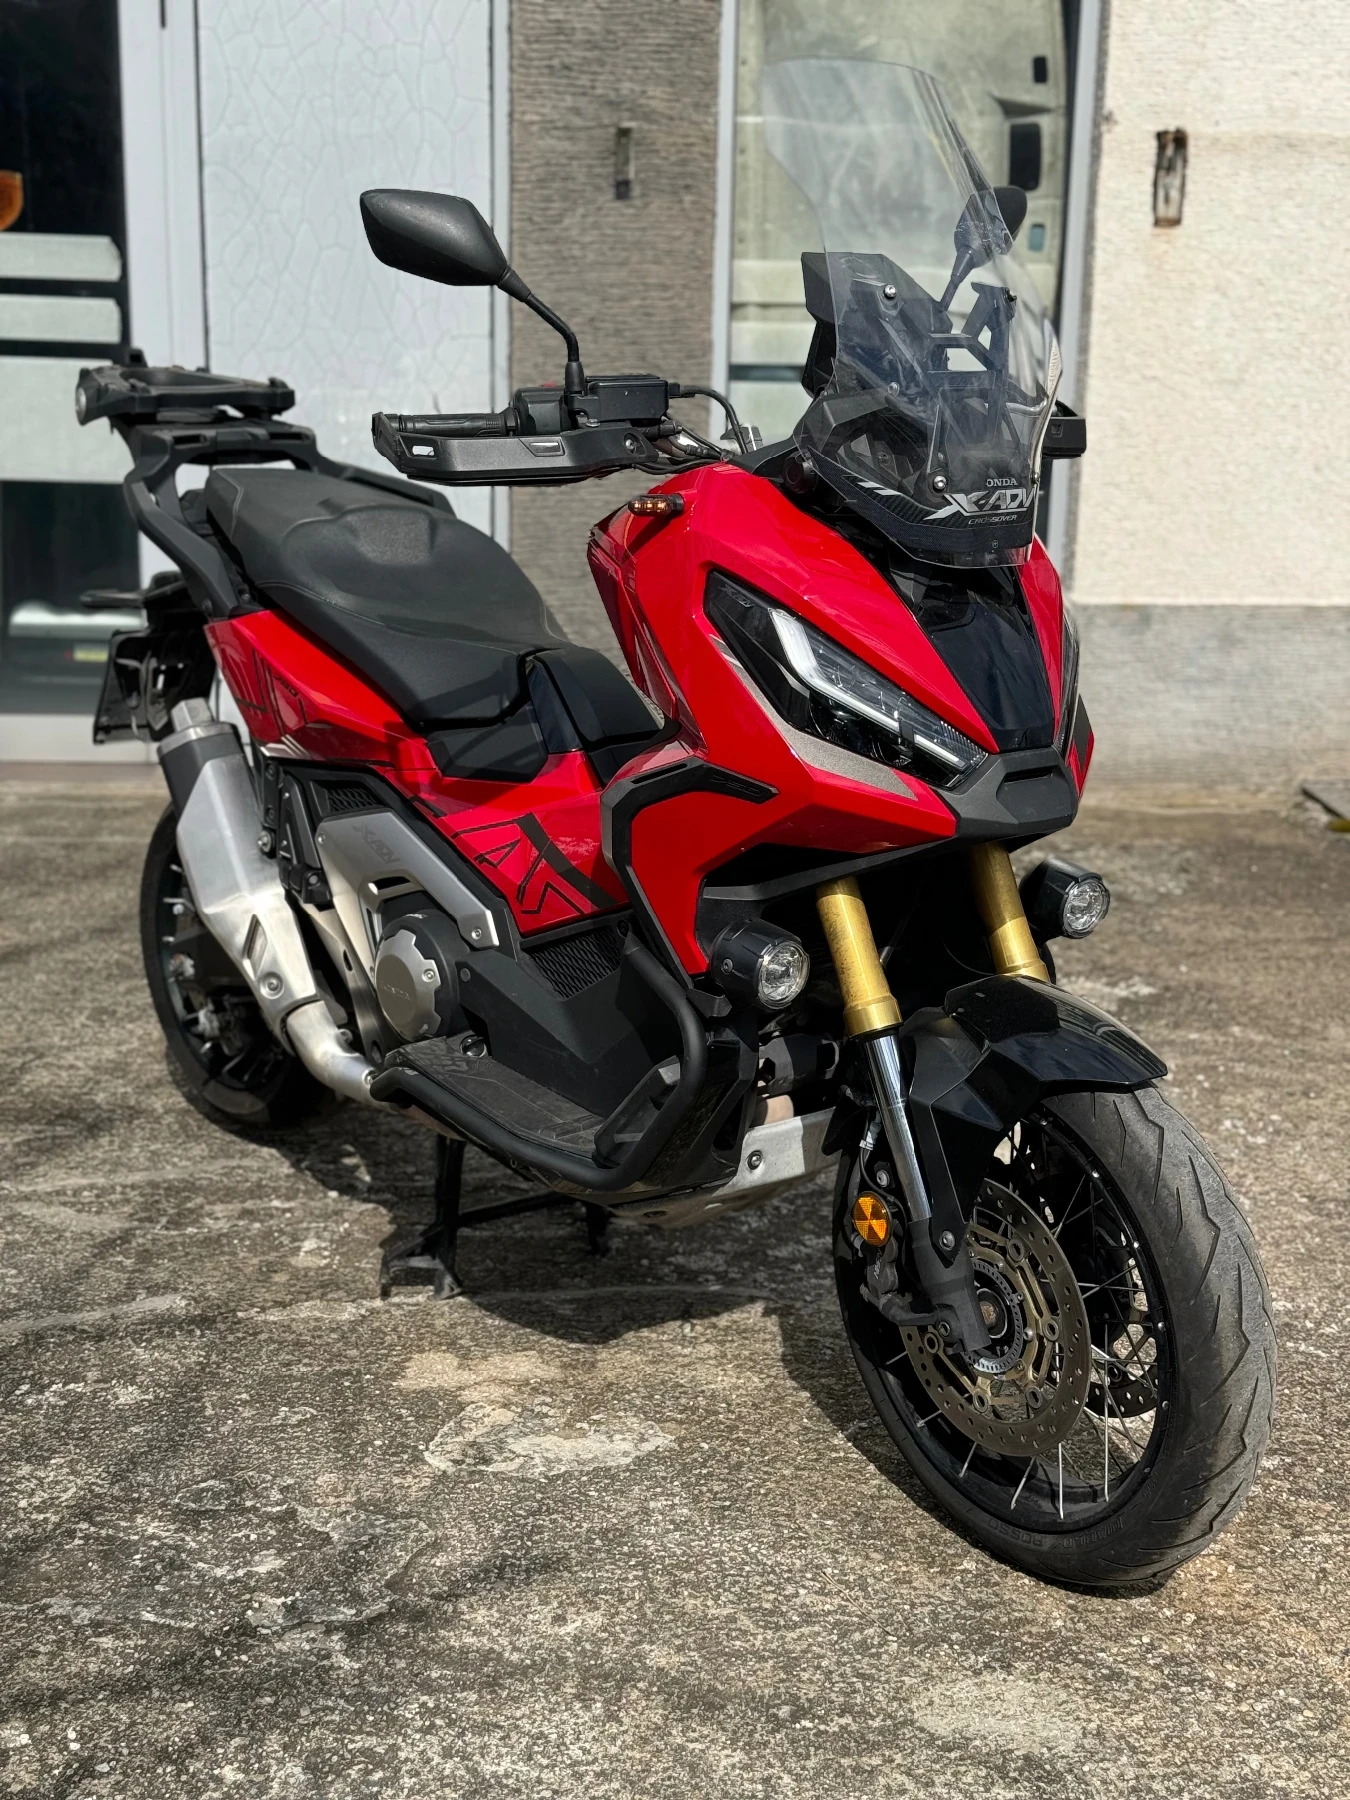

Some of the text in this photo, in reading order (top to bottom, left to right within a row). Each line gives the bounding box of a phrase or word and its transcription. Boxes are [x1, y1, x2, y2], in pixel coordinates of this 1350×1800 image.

[923, 488, 1037, 520] X-ADV
[968, 514, 1018, 525] CROSSOVER
[987, 1518, 1043, 1547] ROSSO
